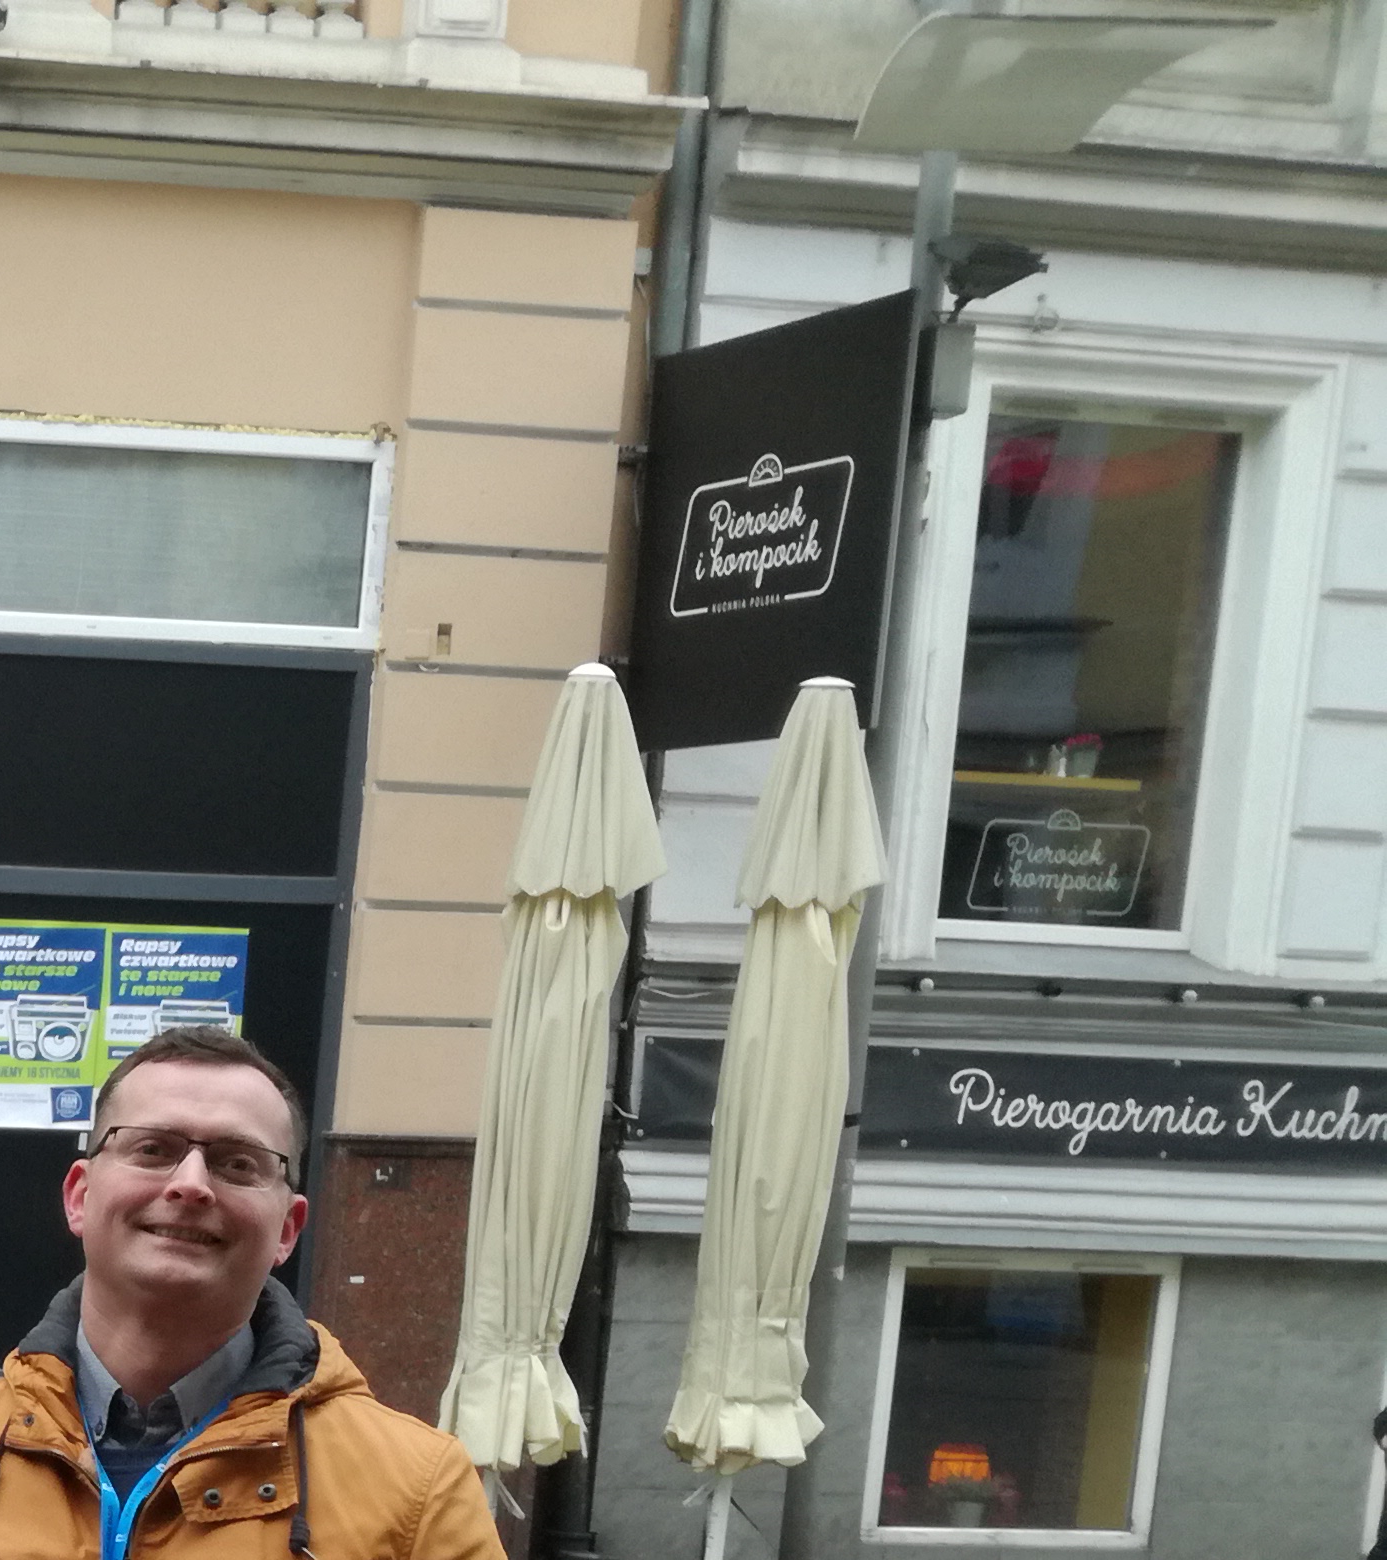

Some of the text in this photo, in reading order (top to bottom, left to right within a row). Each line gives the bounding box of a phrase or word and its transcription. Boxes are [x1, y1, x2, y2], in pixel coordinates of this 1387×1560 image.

[709, 485, 806, 542] Pierożek
[695, 519, 822, 588] i kompocik
[1008, 859, 1121, 902] kompocik
[118, 938, 181, 953] Rapsy
[118, 953, 238, 967] czwartkowe
[3, 965, 78, 976] starsze
[119, 969, 221, 982] te starsze
[118, 984, 183, 996] i nowe
[26, 1066, 36, 1077] 18
[38, 1067, 81, 1078] STYCZNIA
[949, 1067, 1226, 1156] Pierogarnia
